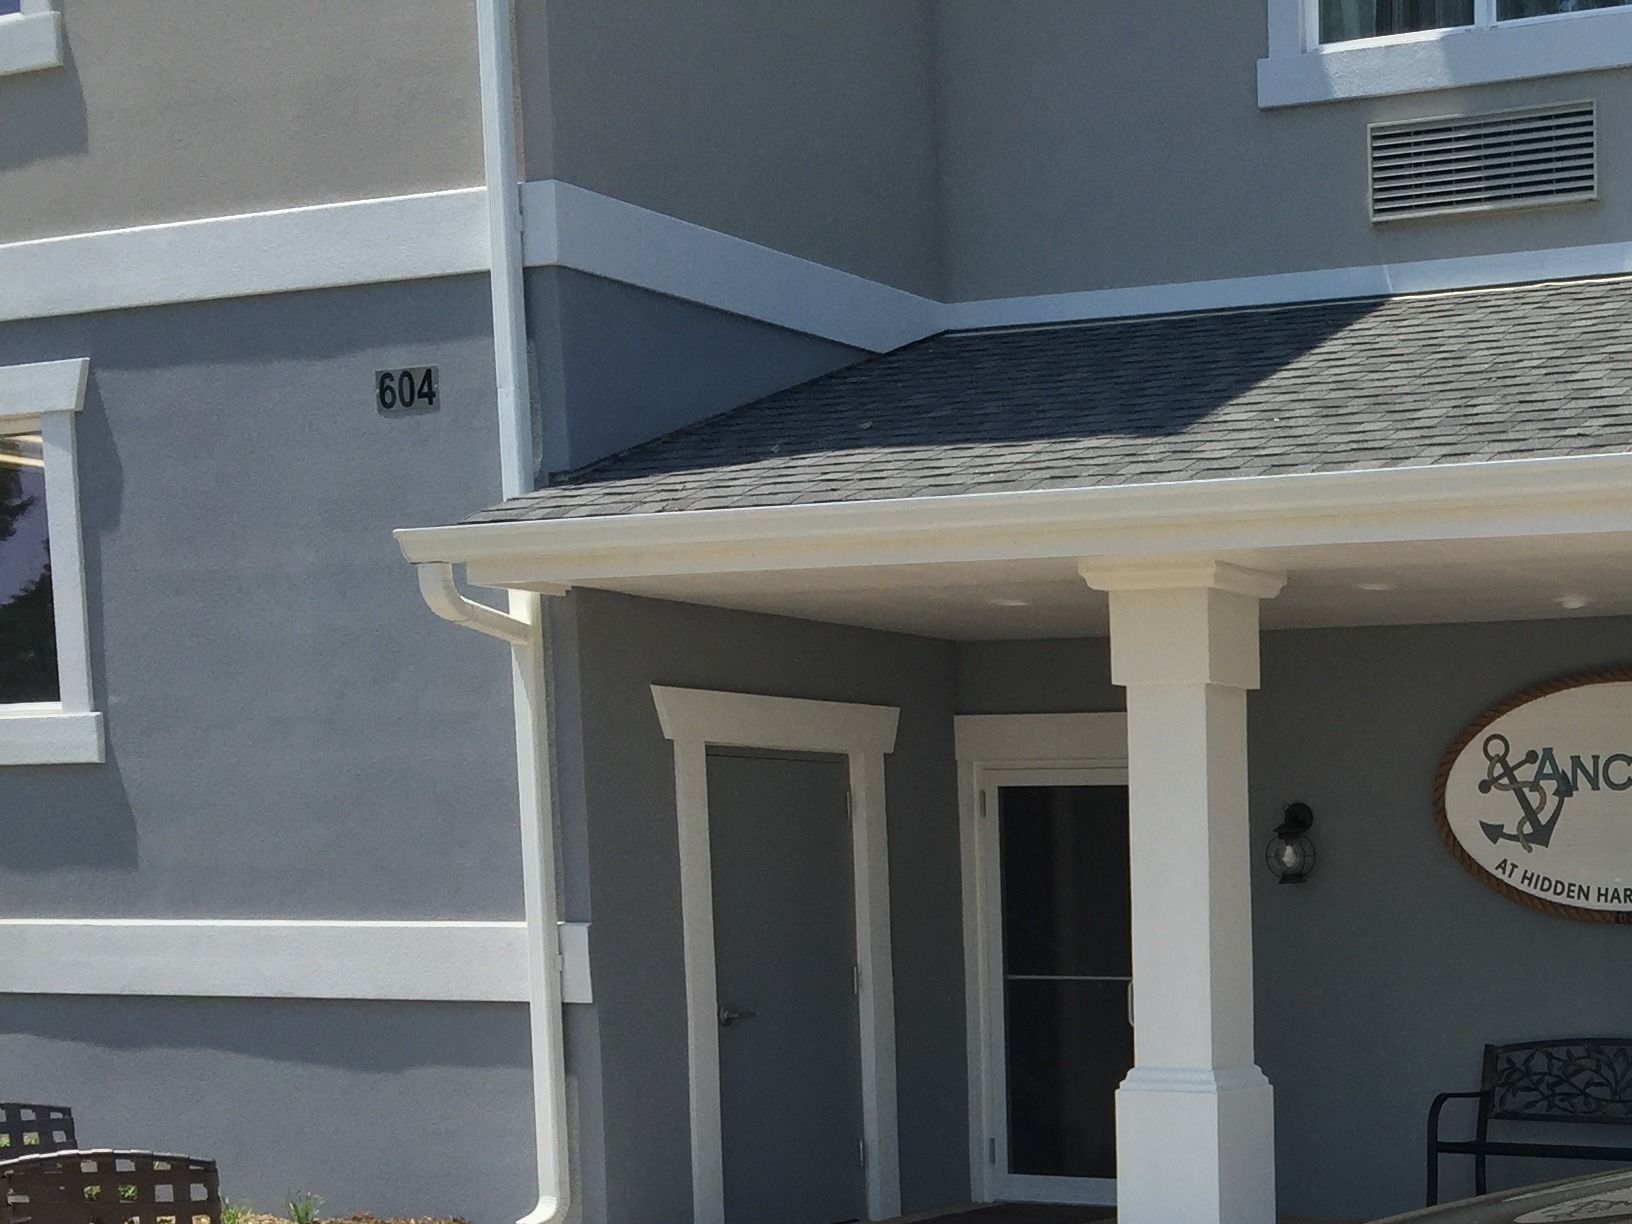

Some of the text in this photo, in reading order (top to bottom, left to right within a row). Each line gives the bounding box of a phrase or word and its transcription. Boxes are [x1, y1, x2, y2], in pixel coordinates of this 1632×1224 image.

[379, 368, 436, 409] 604
[1494, 858, 1518, 878] AT
[1520, 869, 1591, 902] HIDDEN
